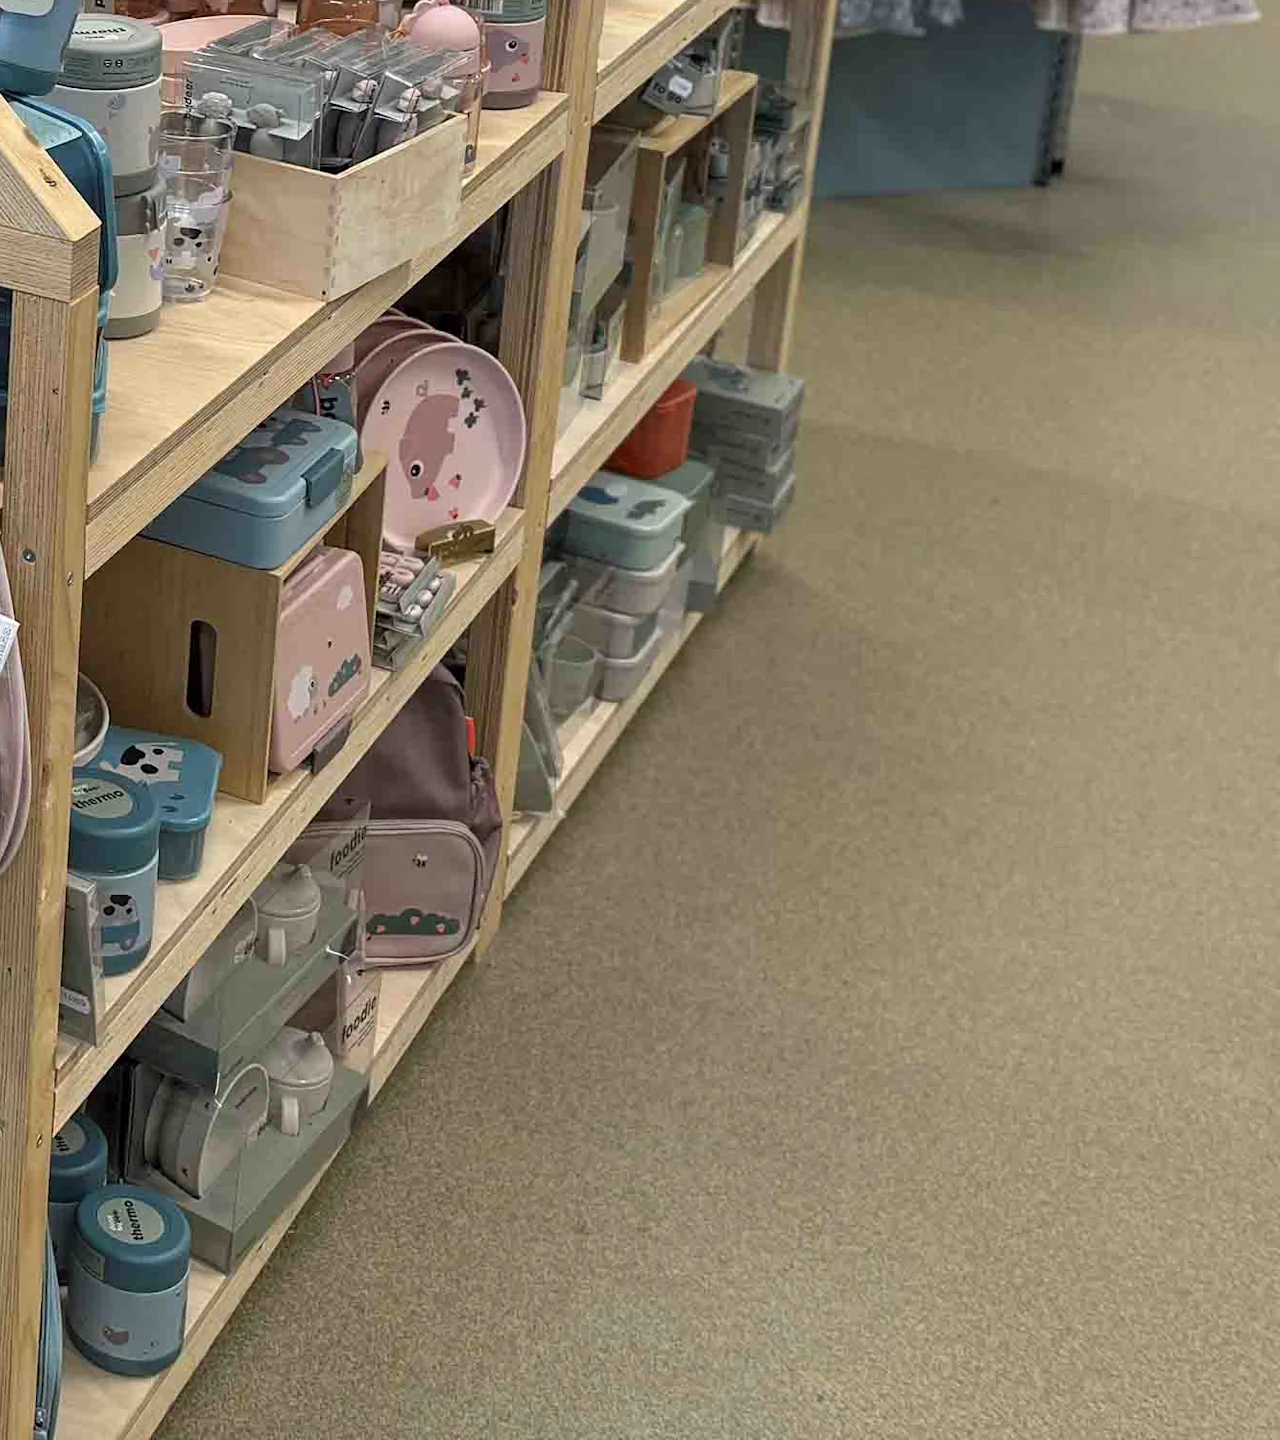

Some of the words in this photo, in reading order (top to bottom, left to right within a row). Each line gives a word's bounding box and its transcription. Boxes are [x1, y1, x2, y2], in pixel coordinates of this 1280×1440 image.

[72, 790, 124, 809] thermo
[329, 825, 367, 873] foodie
[341, 994, 377, 1043] foodie
[124, 1199, 145, 1241] thermo
